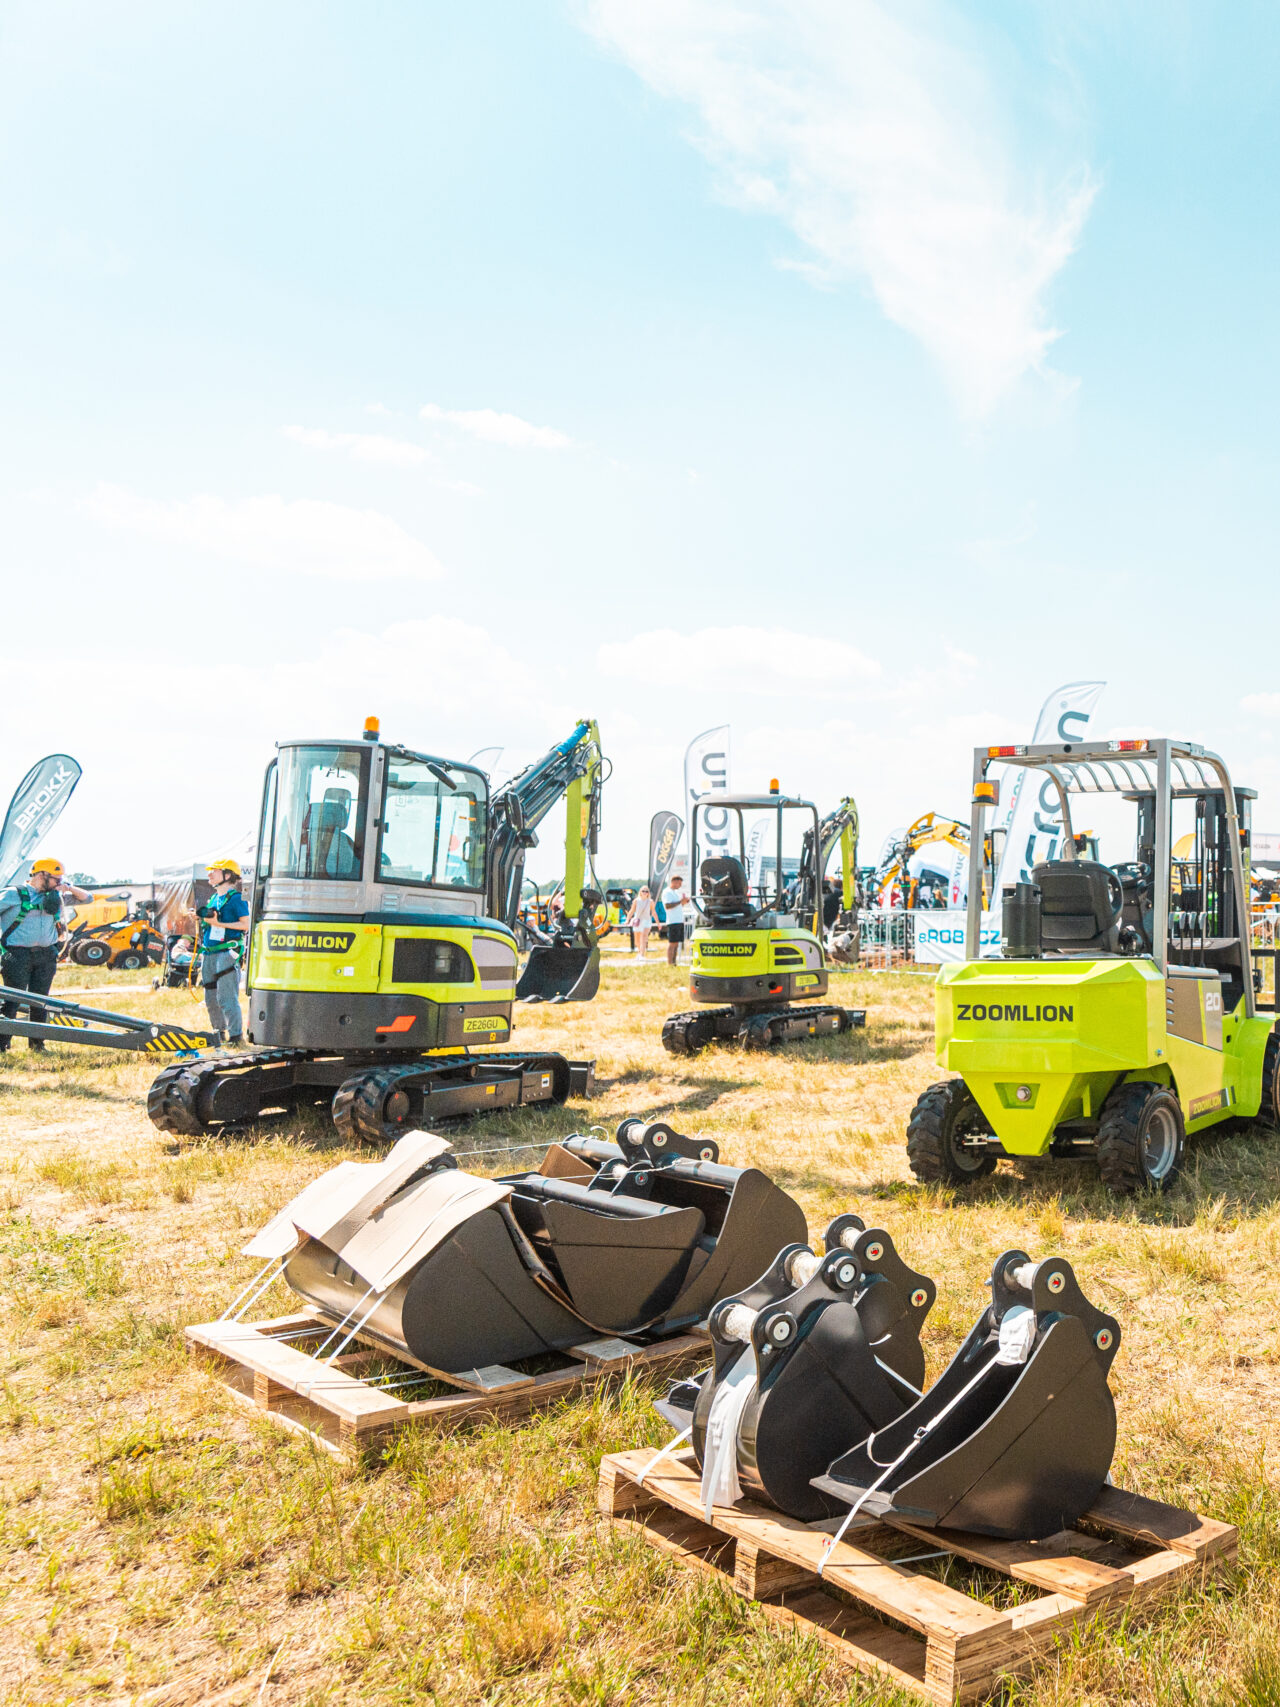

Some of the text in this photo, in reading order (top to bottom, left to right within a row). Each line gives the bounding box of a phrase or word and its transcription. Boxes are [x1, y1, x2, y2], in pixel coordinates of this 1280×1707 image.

[13, 762, 72, 831] BROKK
[658, 828, 676, 864] DIGGA
[270, 934, 347, 949] ZOOMLION
[702, 945, 752, 955] ZOOMLION
[1205, 992, 1221, 1011] 20
[957, 1004, 1073, 1022] ZOOMLION
[466, 1019, 498, 1031] ZE26GU
